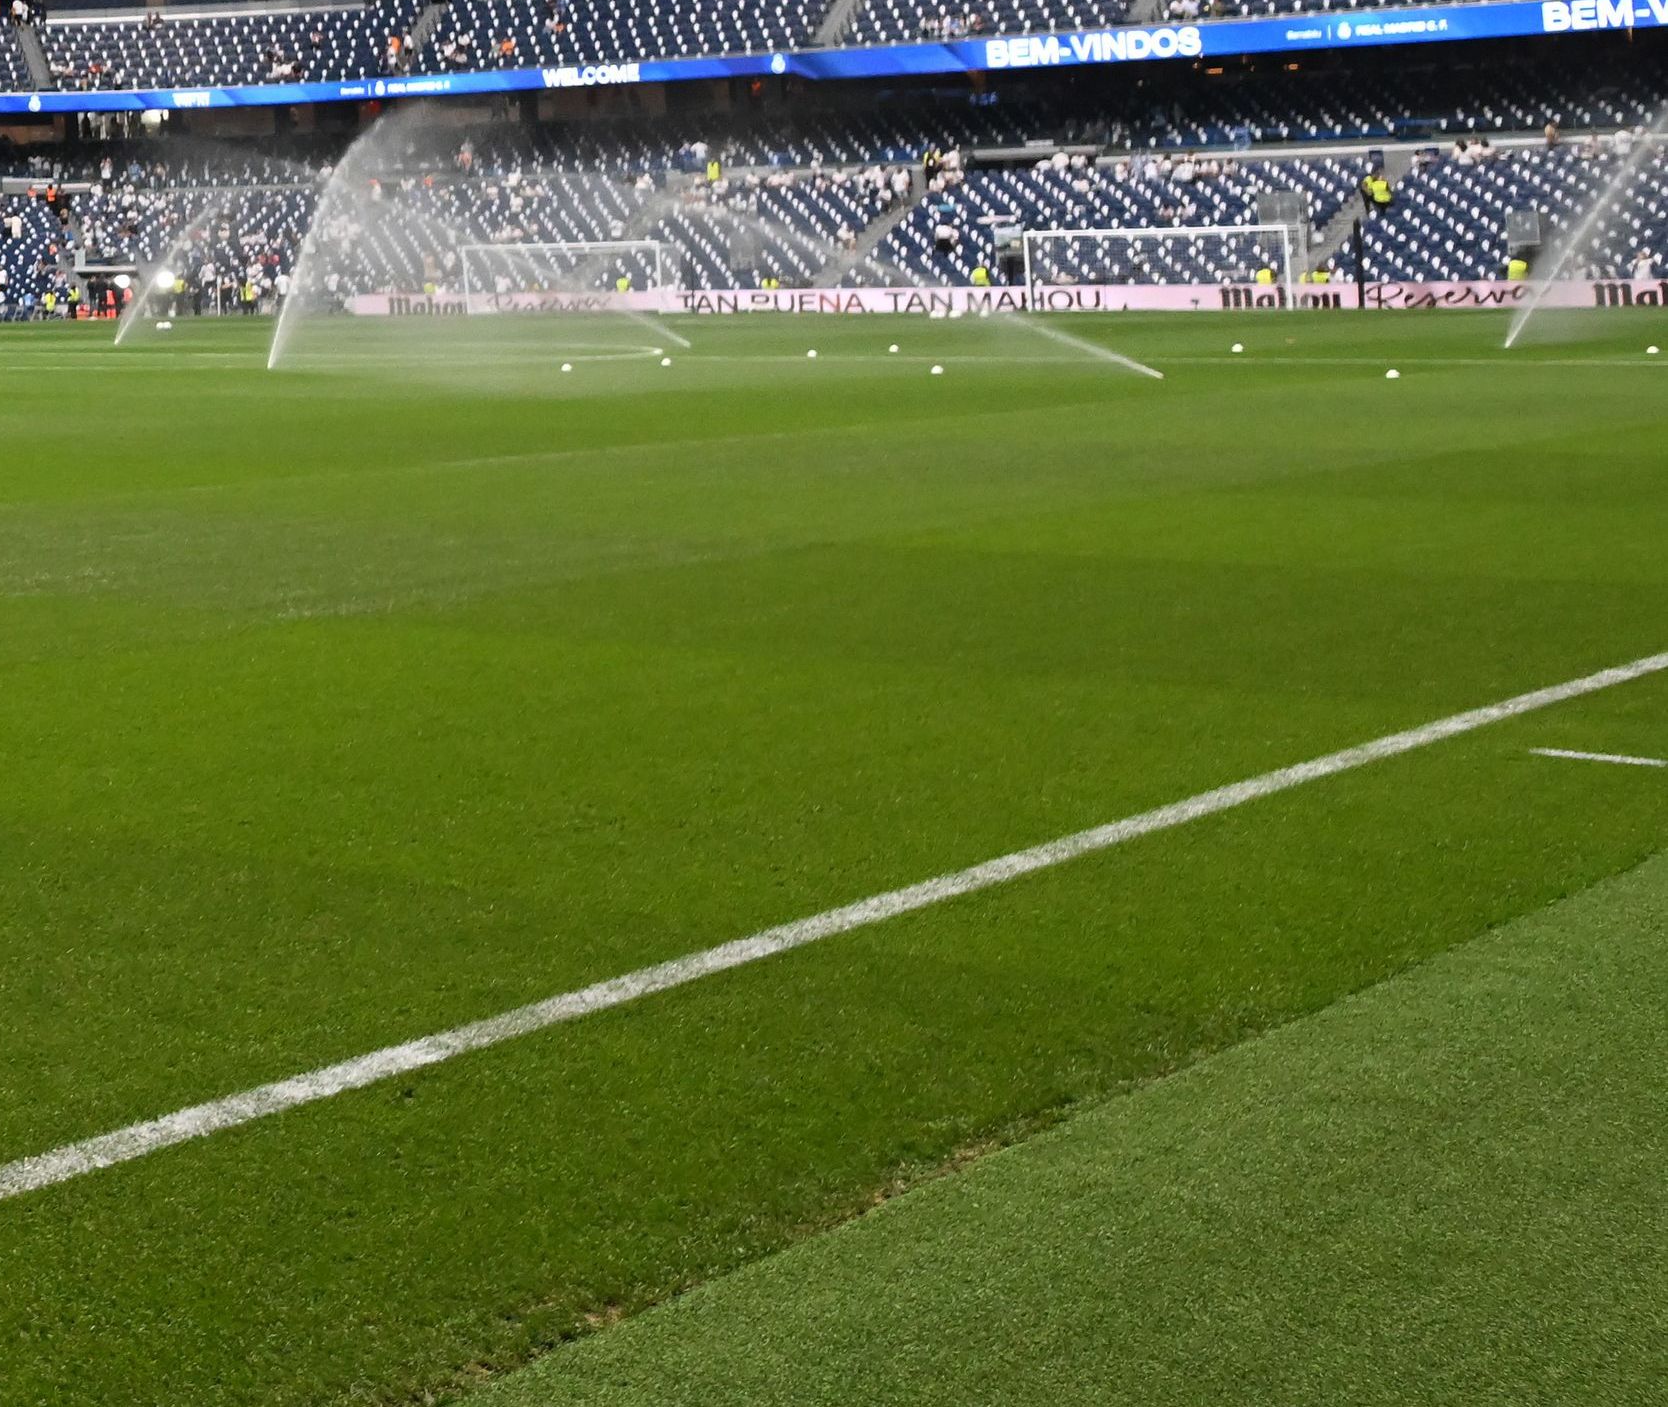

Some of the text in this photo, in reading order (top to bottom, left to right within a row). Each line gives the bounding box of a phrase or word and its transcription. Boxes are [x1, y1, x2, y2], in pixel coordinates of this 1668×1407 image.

[986, 27, 1202, 68] BEM-VINDOS
[542, 64, 640, 88] WELCOME
[676, 293, 738, 314] TAN
[885, 292, 953, 312] TAN
